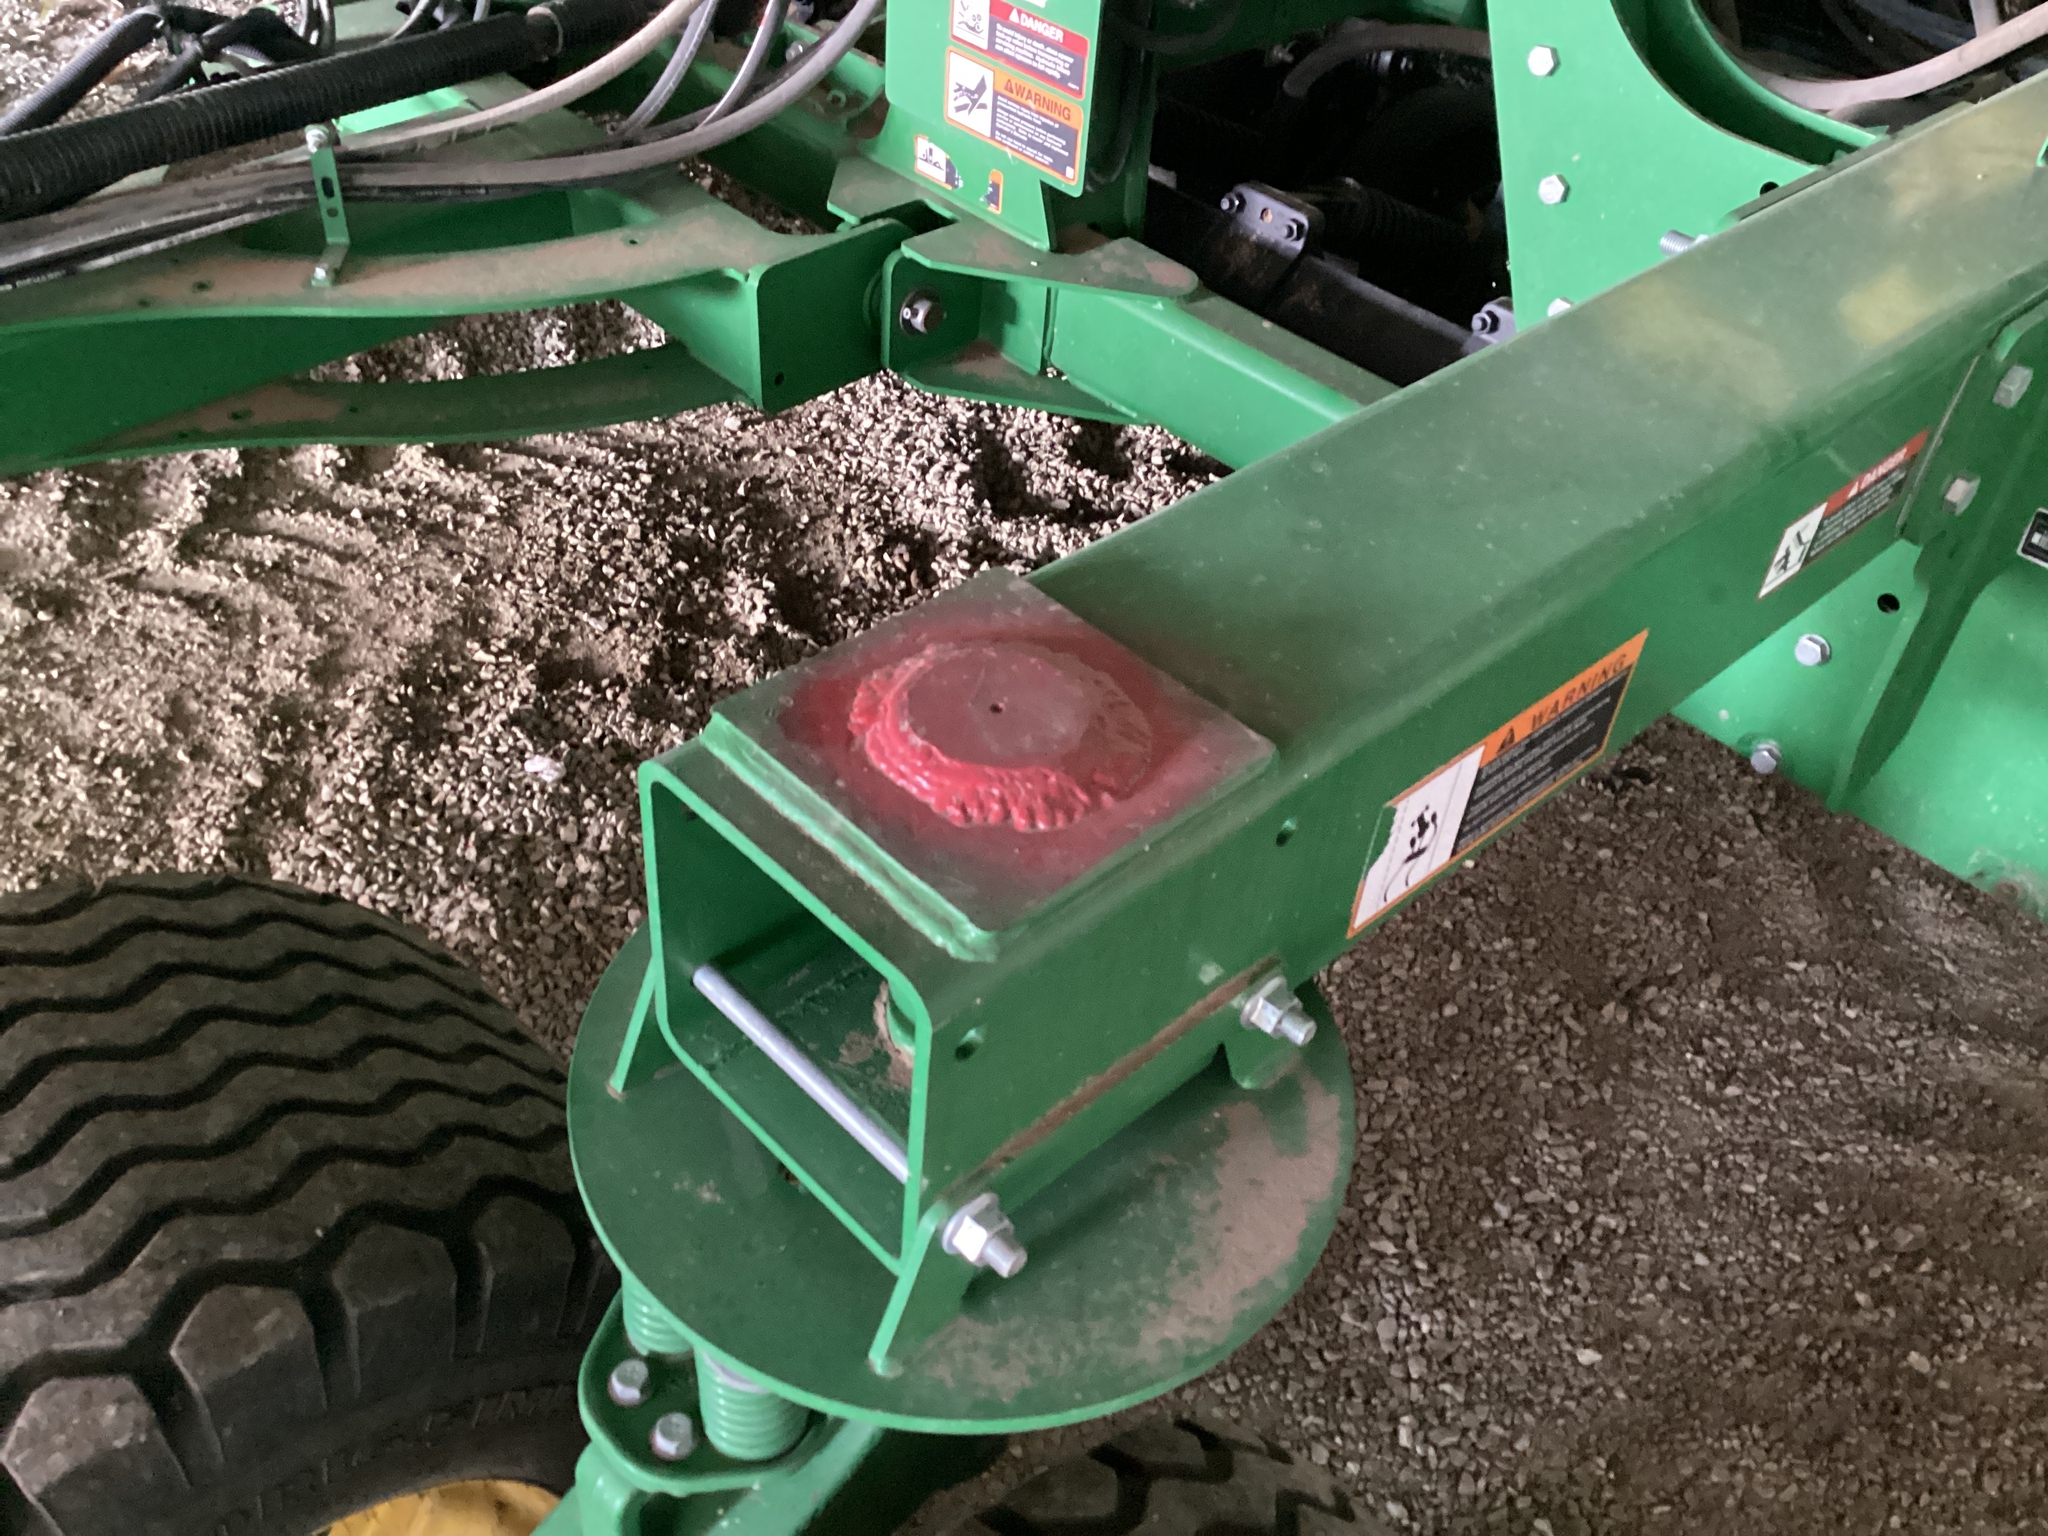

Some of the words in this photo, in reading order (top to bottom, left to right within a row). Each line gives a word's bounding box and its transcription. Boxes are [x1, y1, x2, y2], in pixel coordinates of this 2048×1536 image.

[1020, 13, 1064, 43] DANGER
[1015, 82, 1071, 122] WARNING
[1531, 654, 1628, 732] WARNING
